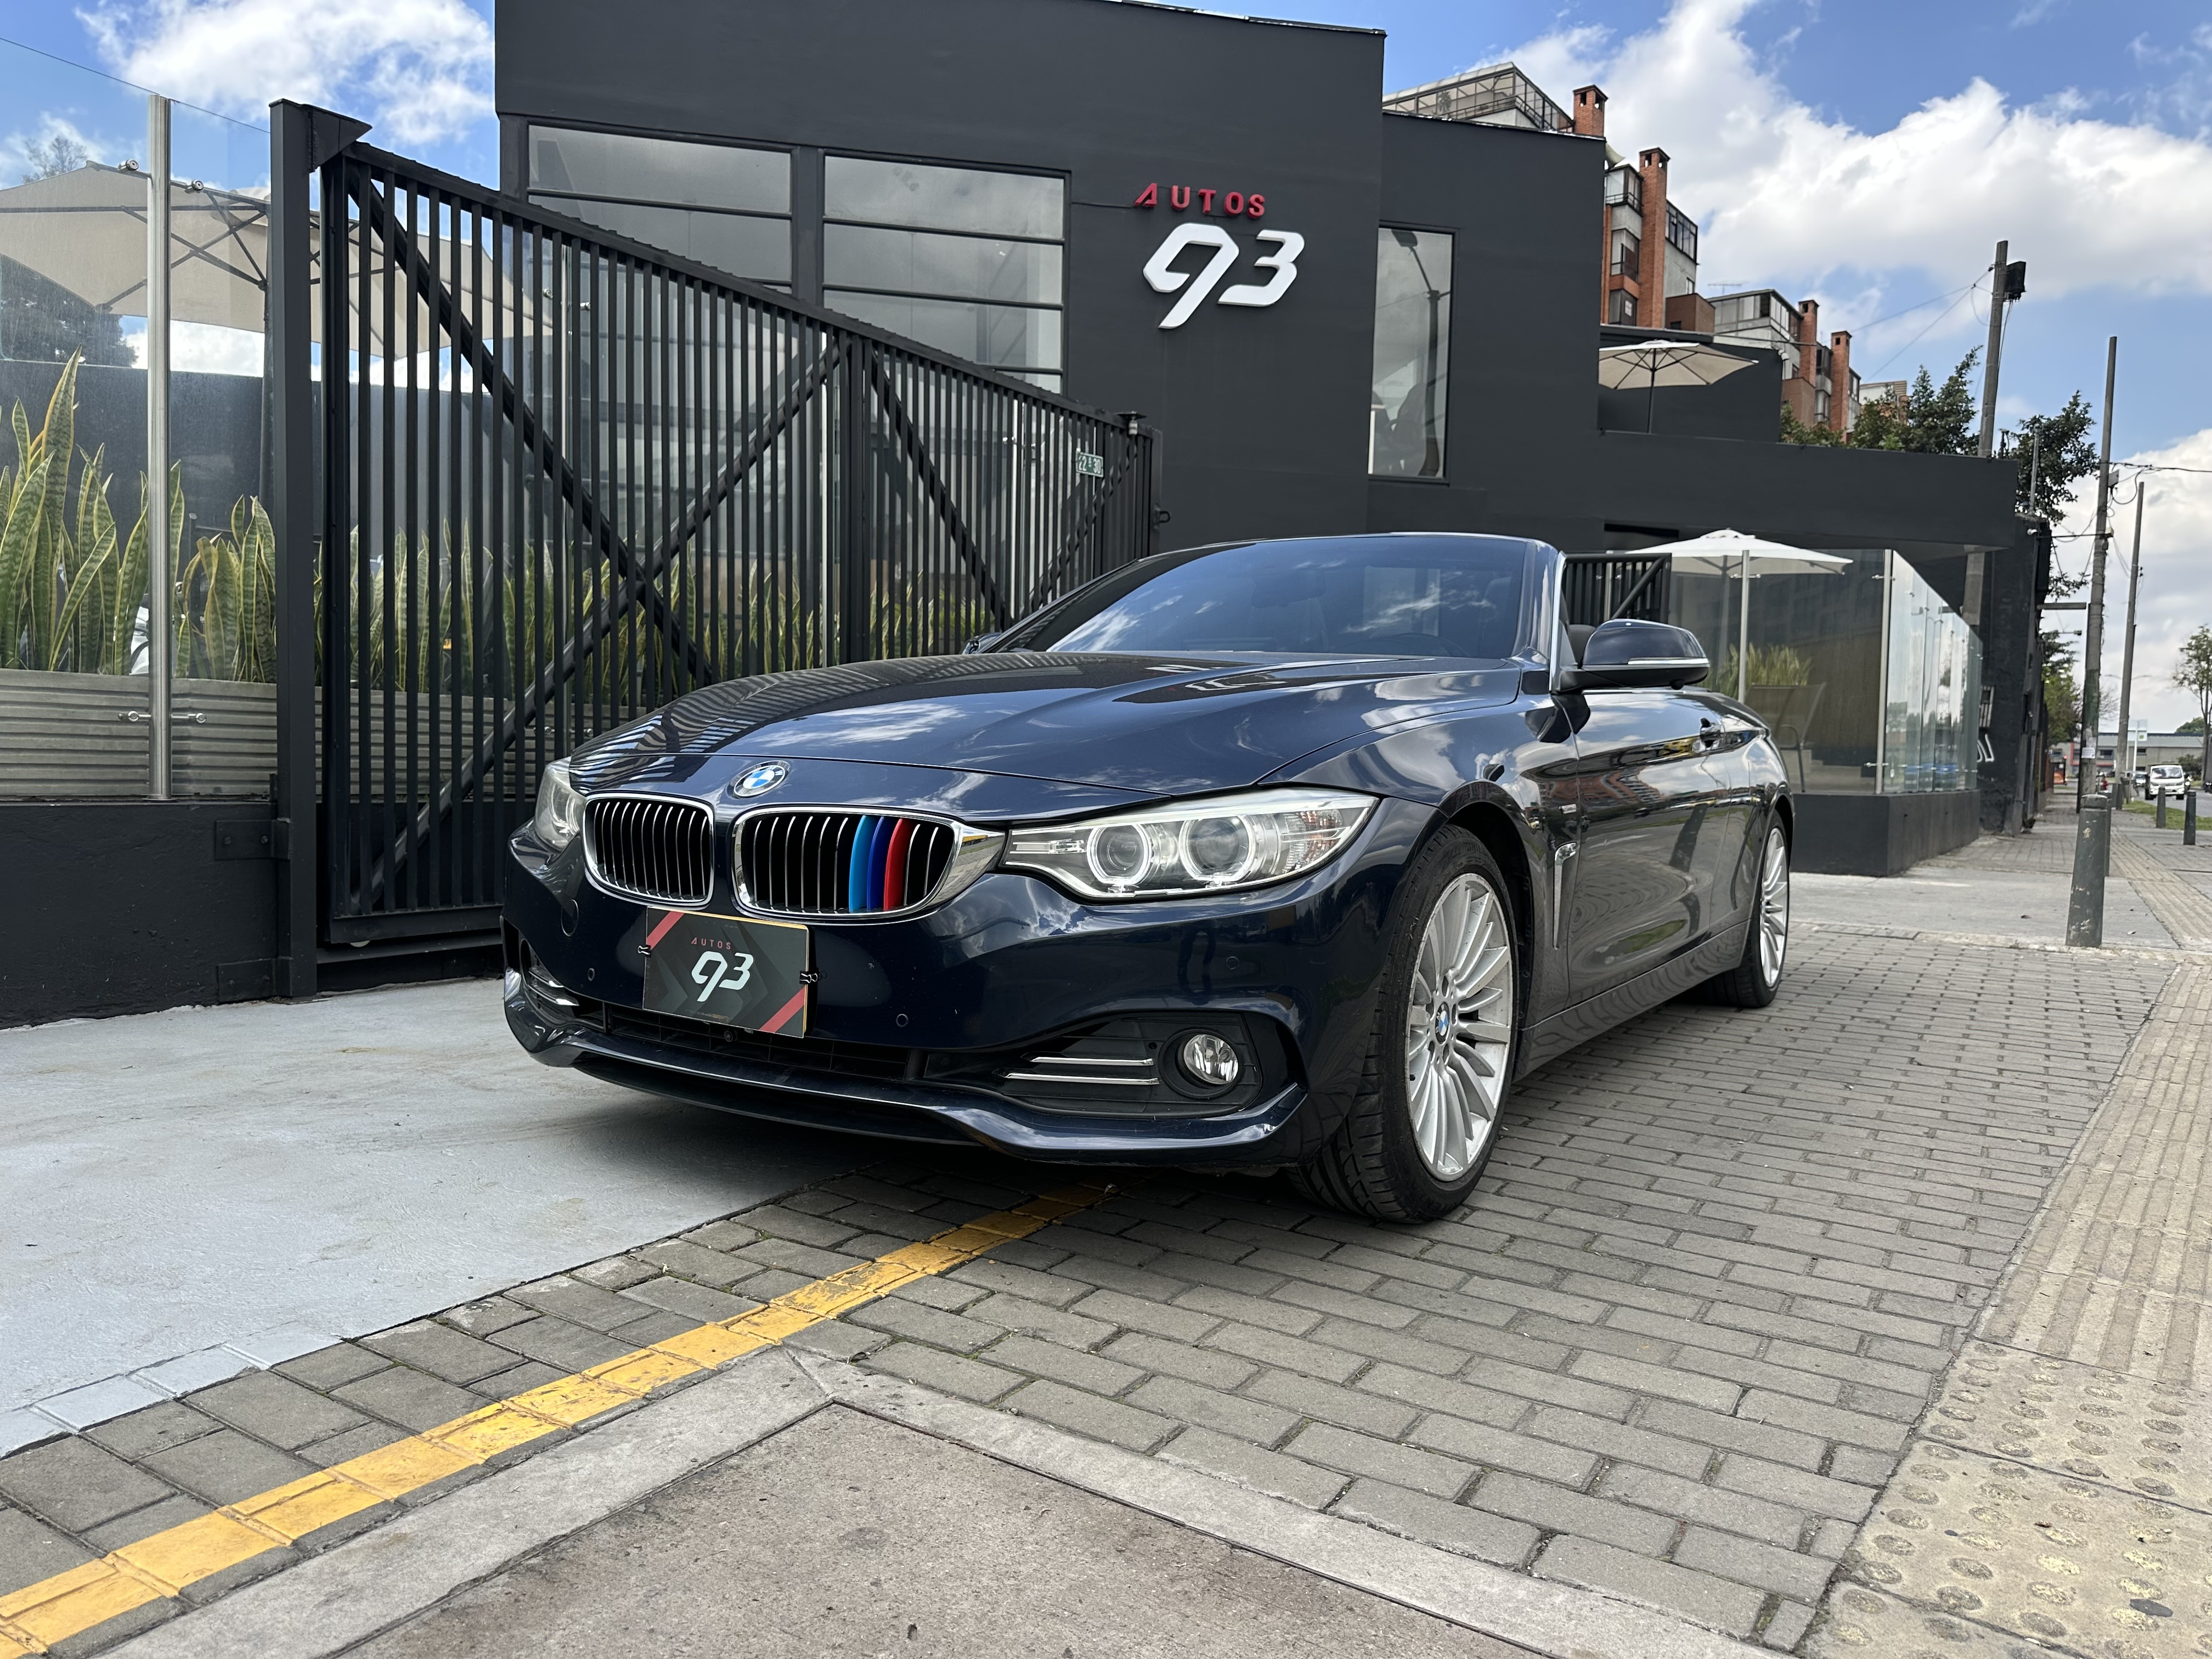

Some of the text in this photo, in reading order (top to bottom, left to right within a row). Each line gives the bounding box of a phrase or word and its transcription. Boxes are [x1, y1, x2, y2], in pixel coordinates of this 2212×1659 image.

[1134, 183, 1266, 218] AUTOS
[1143, 222, 1305, 329] 93
[691, 937, 731, 950] AUTOS
[691, 951, 754, 1002] 93
